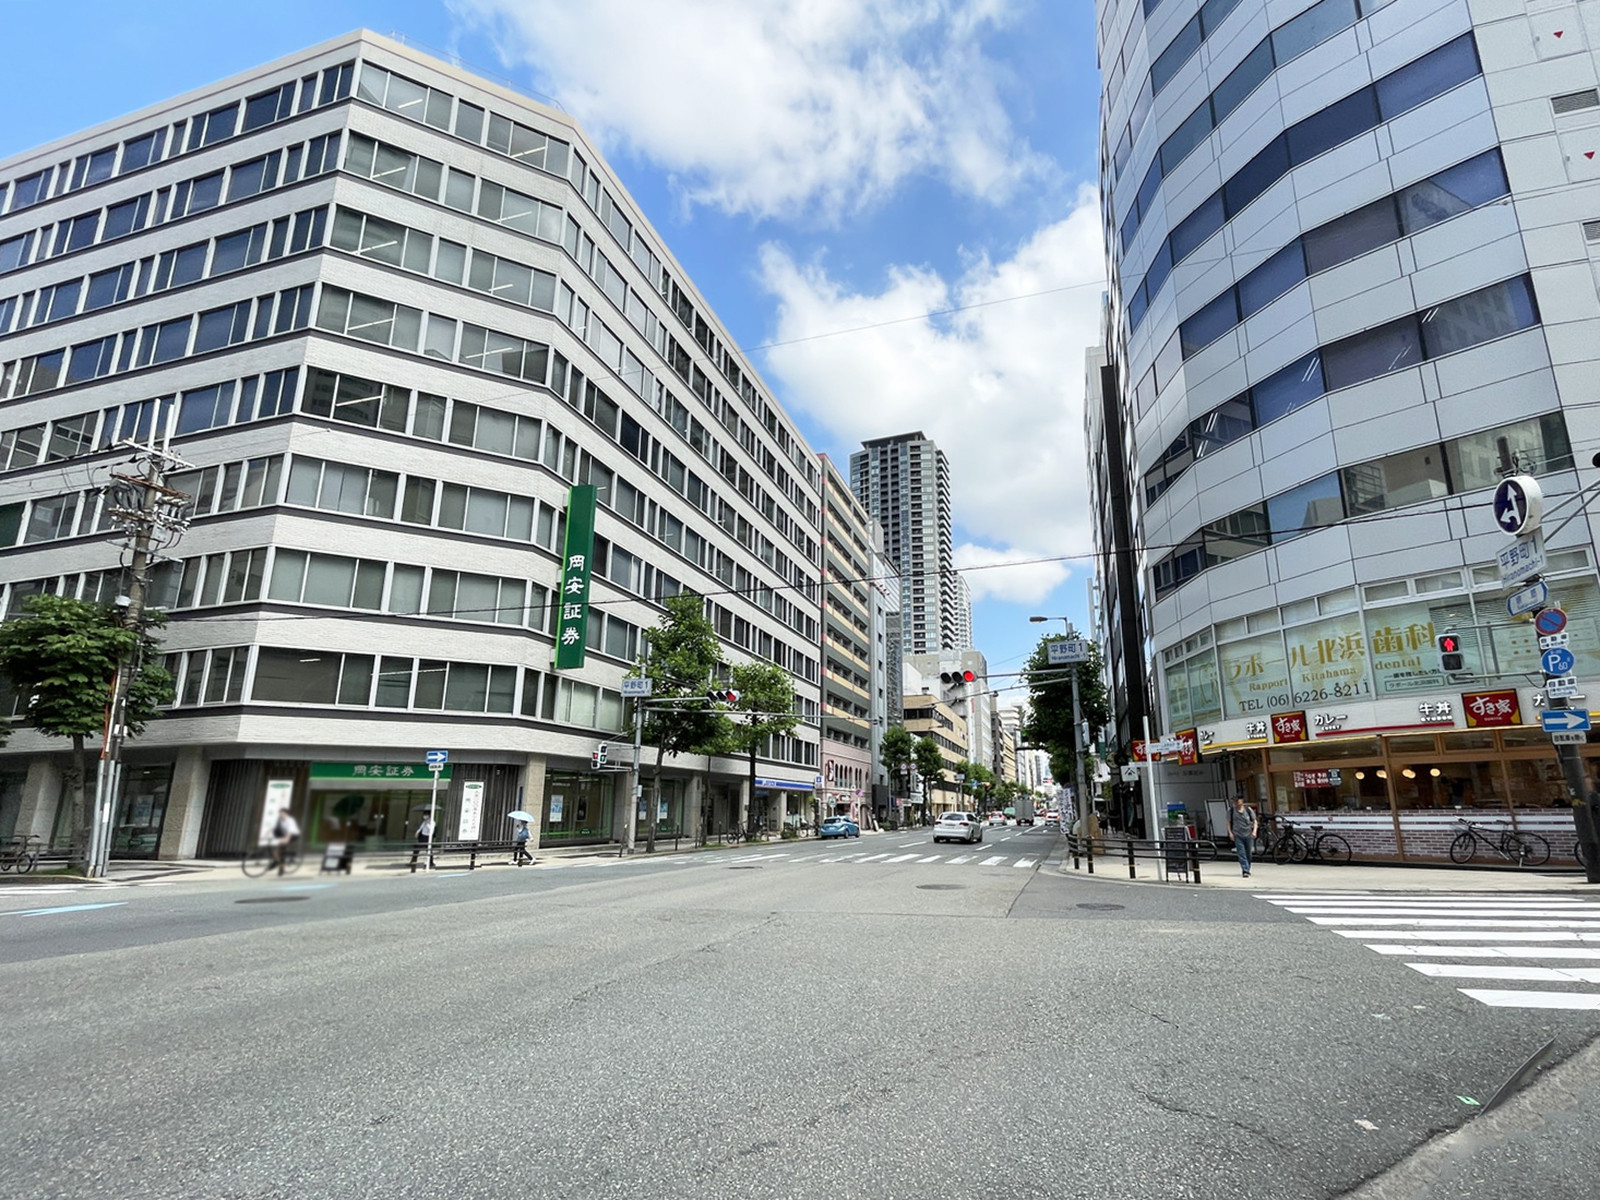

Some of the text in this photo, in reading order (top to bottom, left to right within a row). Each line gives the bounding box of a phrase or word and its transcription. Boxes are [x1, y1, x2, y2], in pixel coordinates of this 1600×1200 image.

[561, 555, 585, 645] 岡安証券
[1249, 656, 1422, 692] Rapport Kitahama dental
[1239, 681, 1371, 712] TEL (06) 6226-8211
[1419, 701, 1452, 716] 牛丼
[1469, 696, 1512, 717] すき家
[1275, 717, 1302, 734] すき家
[1314, 713, 1348, 726] カレー
[352, 765, 415, 777] 岡安証券
